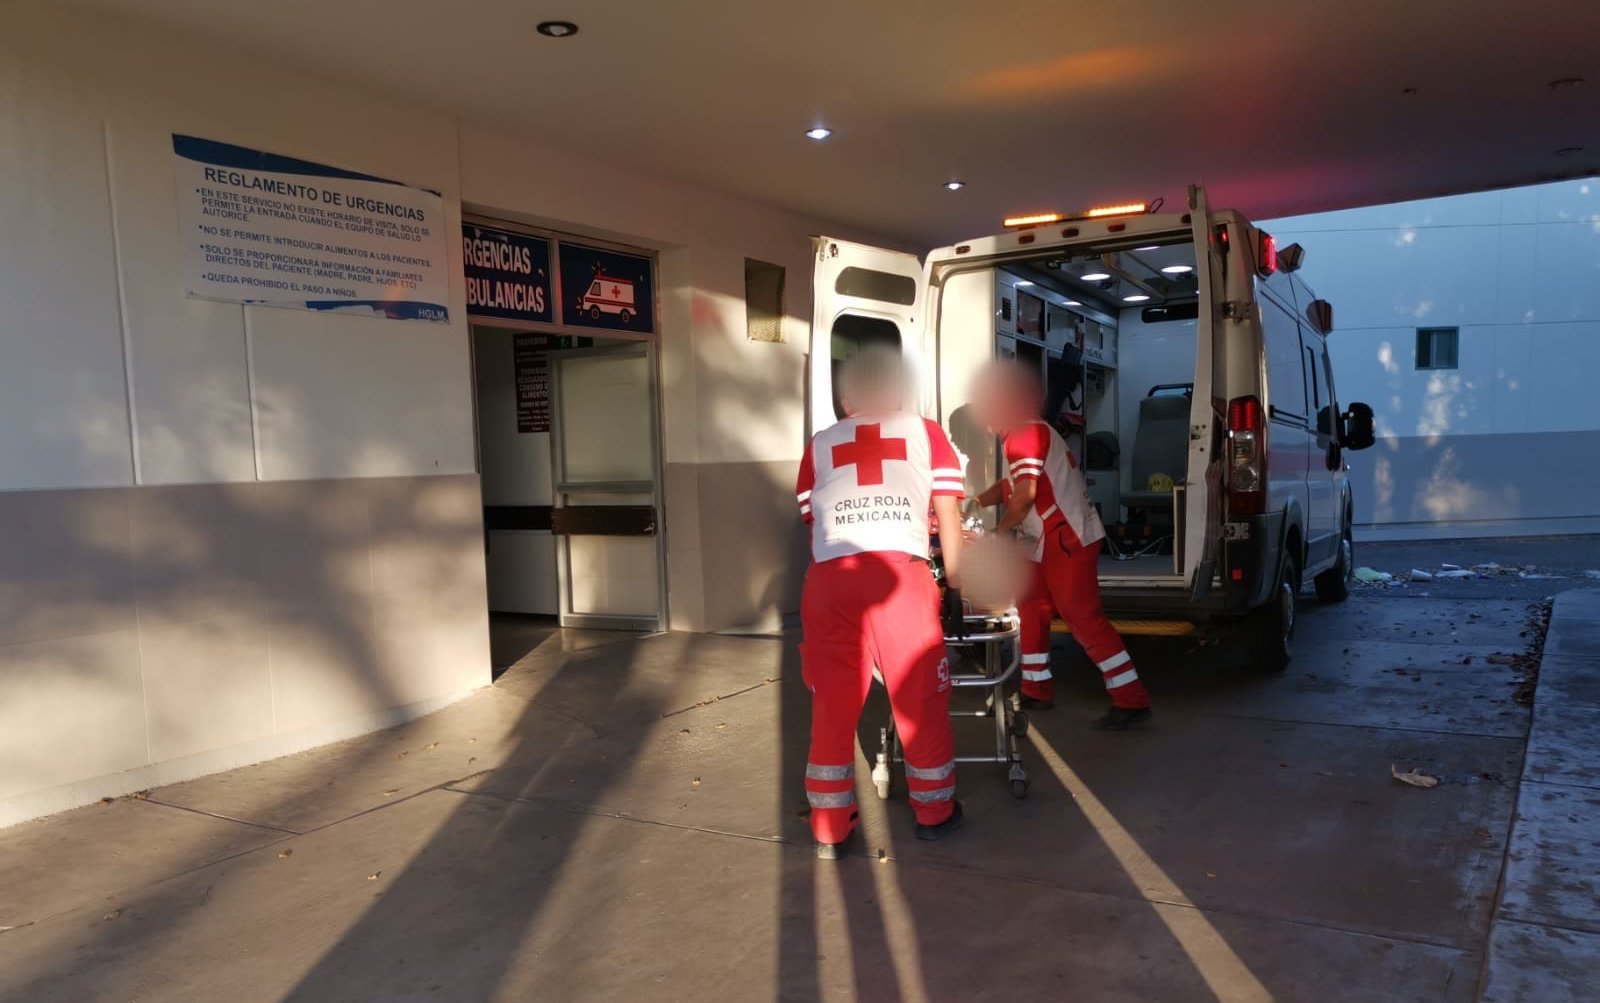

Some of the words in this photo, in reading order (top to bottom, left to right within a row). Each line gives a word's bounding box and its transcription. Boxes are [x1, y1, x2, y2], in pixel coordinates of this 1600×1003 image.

[201, 188, 214, 197] EN
[216, 190, 239, 201] ESTE
[242, 195, 280, 209] SERVICIO
[283, 202, 296, 212] NO
[298, 206, 325, 218] EXISTE
[328, 211, 361, 223] HORARIO
[364, 218, 374, 227] DE
[205, 167, 318, 201] REGLAMENTO
[322, 190, 341, 206] DE
[346, 195, 425, 221] URGENCIAS
[202, 197, 241, 212] PERMITE
[244, 206, 255, 214] LA
[258, 208, 297, 220] ENTRADA
[298, 214, 332, 227] CUANDO
[334, 220, 344, 228] EL
[346, 222, 374, 234] EQUIPO
[376, 228, 386, 236] DE
[387, 230, 410, 240] SALUD
[412, 234, 421, 242] LO
[204, 226, 218, 235] NO
[220, 228, 232, 237] SE
[234, 230, 272, 242] PERMITE
[274, 237, 324, 250] INTRODUCIR
[325, 244, 368, 258] ALIMENTOS
[376, 252, 391, 260] LOS
[464, 237, 532, 275] RGENCIAS
[206, 244, 231, 255] SOLO
[233, 248, 245, 257] SE
[322, 261, 374, 275] INFORMACIÓN
[382, 270, 423, 282] FAMILIARES
[206, 254, 251, 268] DIRECTOS
[254, 260, 270, 270] DEL
[272, 262, 312, 276] PACIENTE
[208, 272, 240, 284] QUEDA
[242, 276, 288, 290] PROHIBIDO
[290, 283, 301, 291] EL
[303, 284, 324, 294] PASO
[465, 277, 544, 314] BULANCIAS
[418, 308, 444, 320] HGLM
[835, 497, 870, 512] CRUZ
[874, 496, 911, 508] ROJA
[836, 510, 912, 526] MEXICANA
